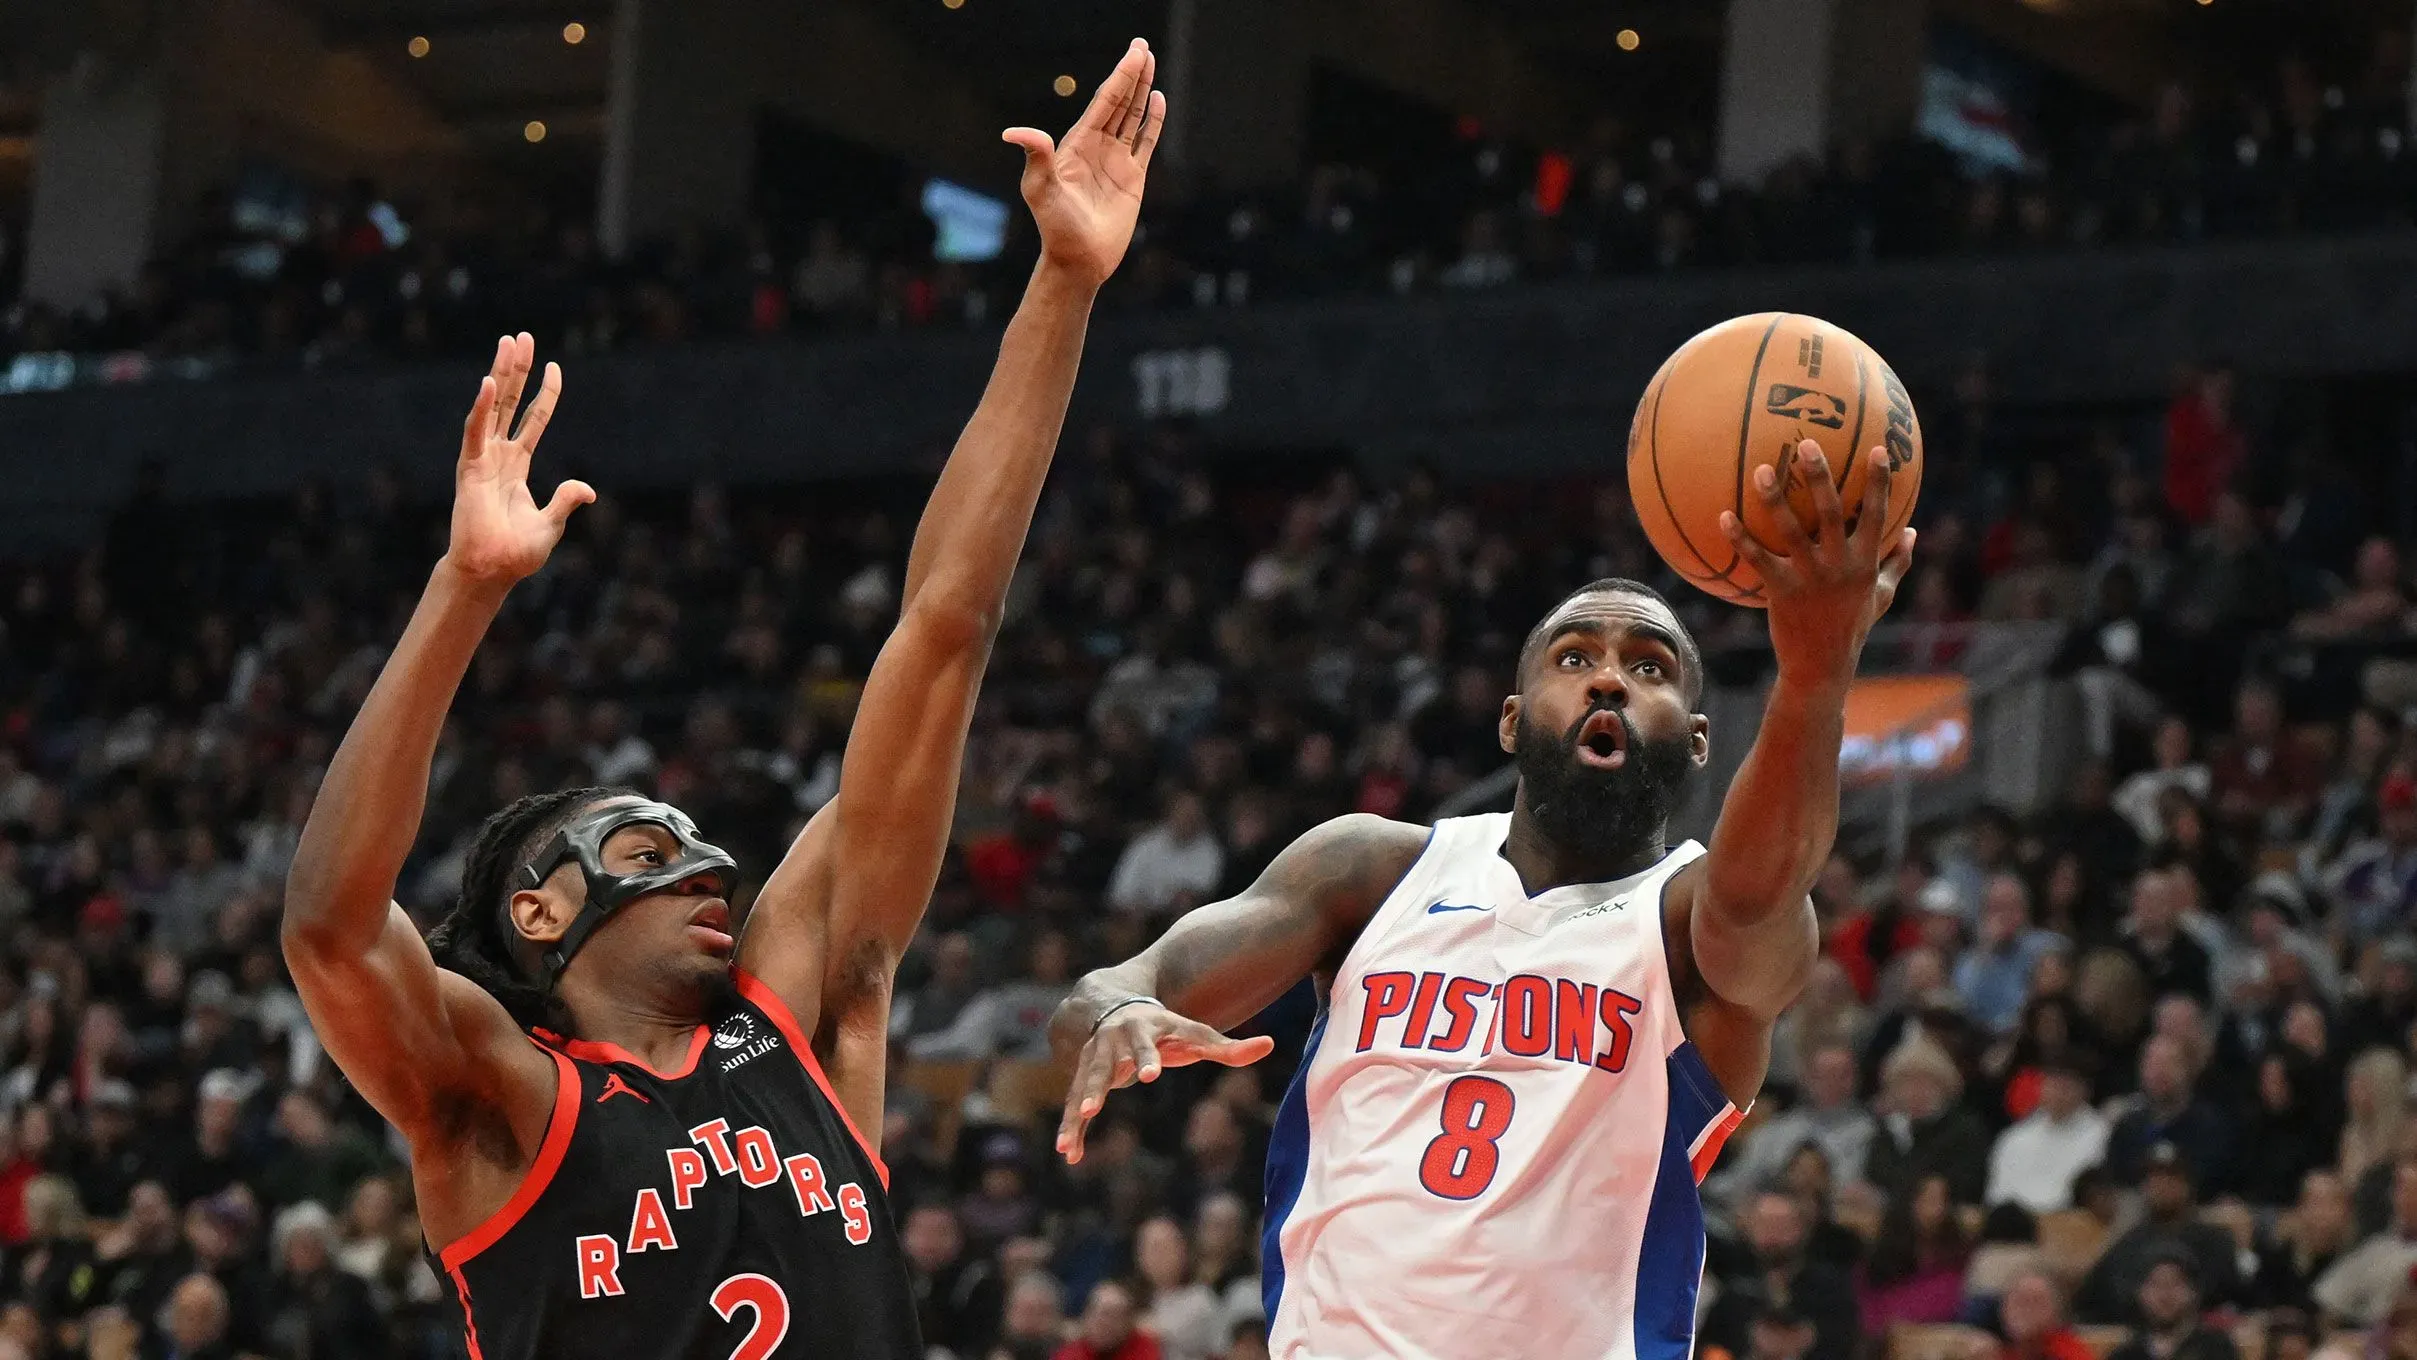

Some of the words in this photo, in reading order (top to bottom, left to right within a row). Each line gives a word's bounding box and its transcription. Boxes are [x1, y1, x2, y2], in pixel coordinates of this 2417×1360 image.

[720, 1052, 750, 1073] Sun
[746, 1035, 780, 1058] Life
[1418, 1074, 1516, 1200] 8
[576, 1117, 872, 1299] RAPTORS
[709, 1272, 790, 1360] 2
